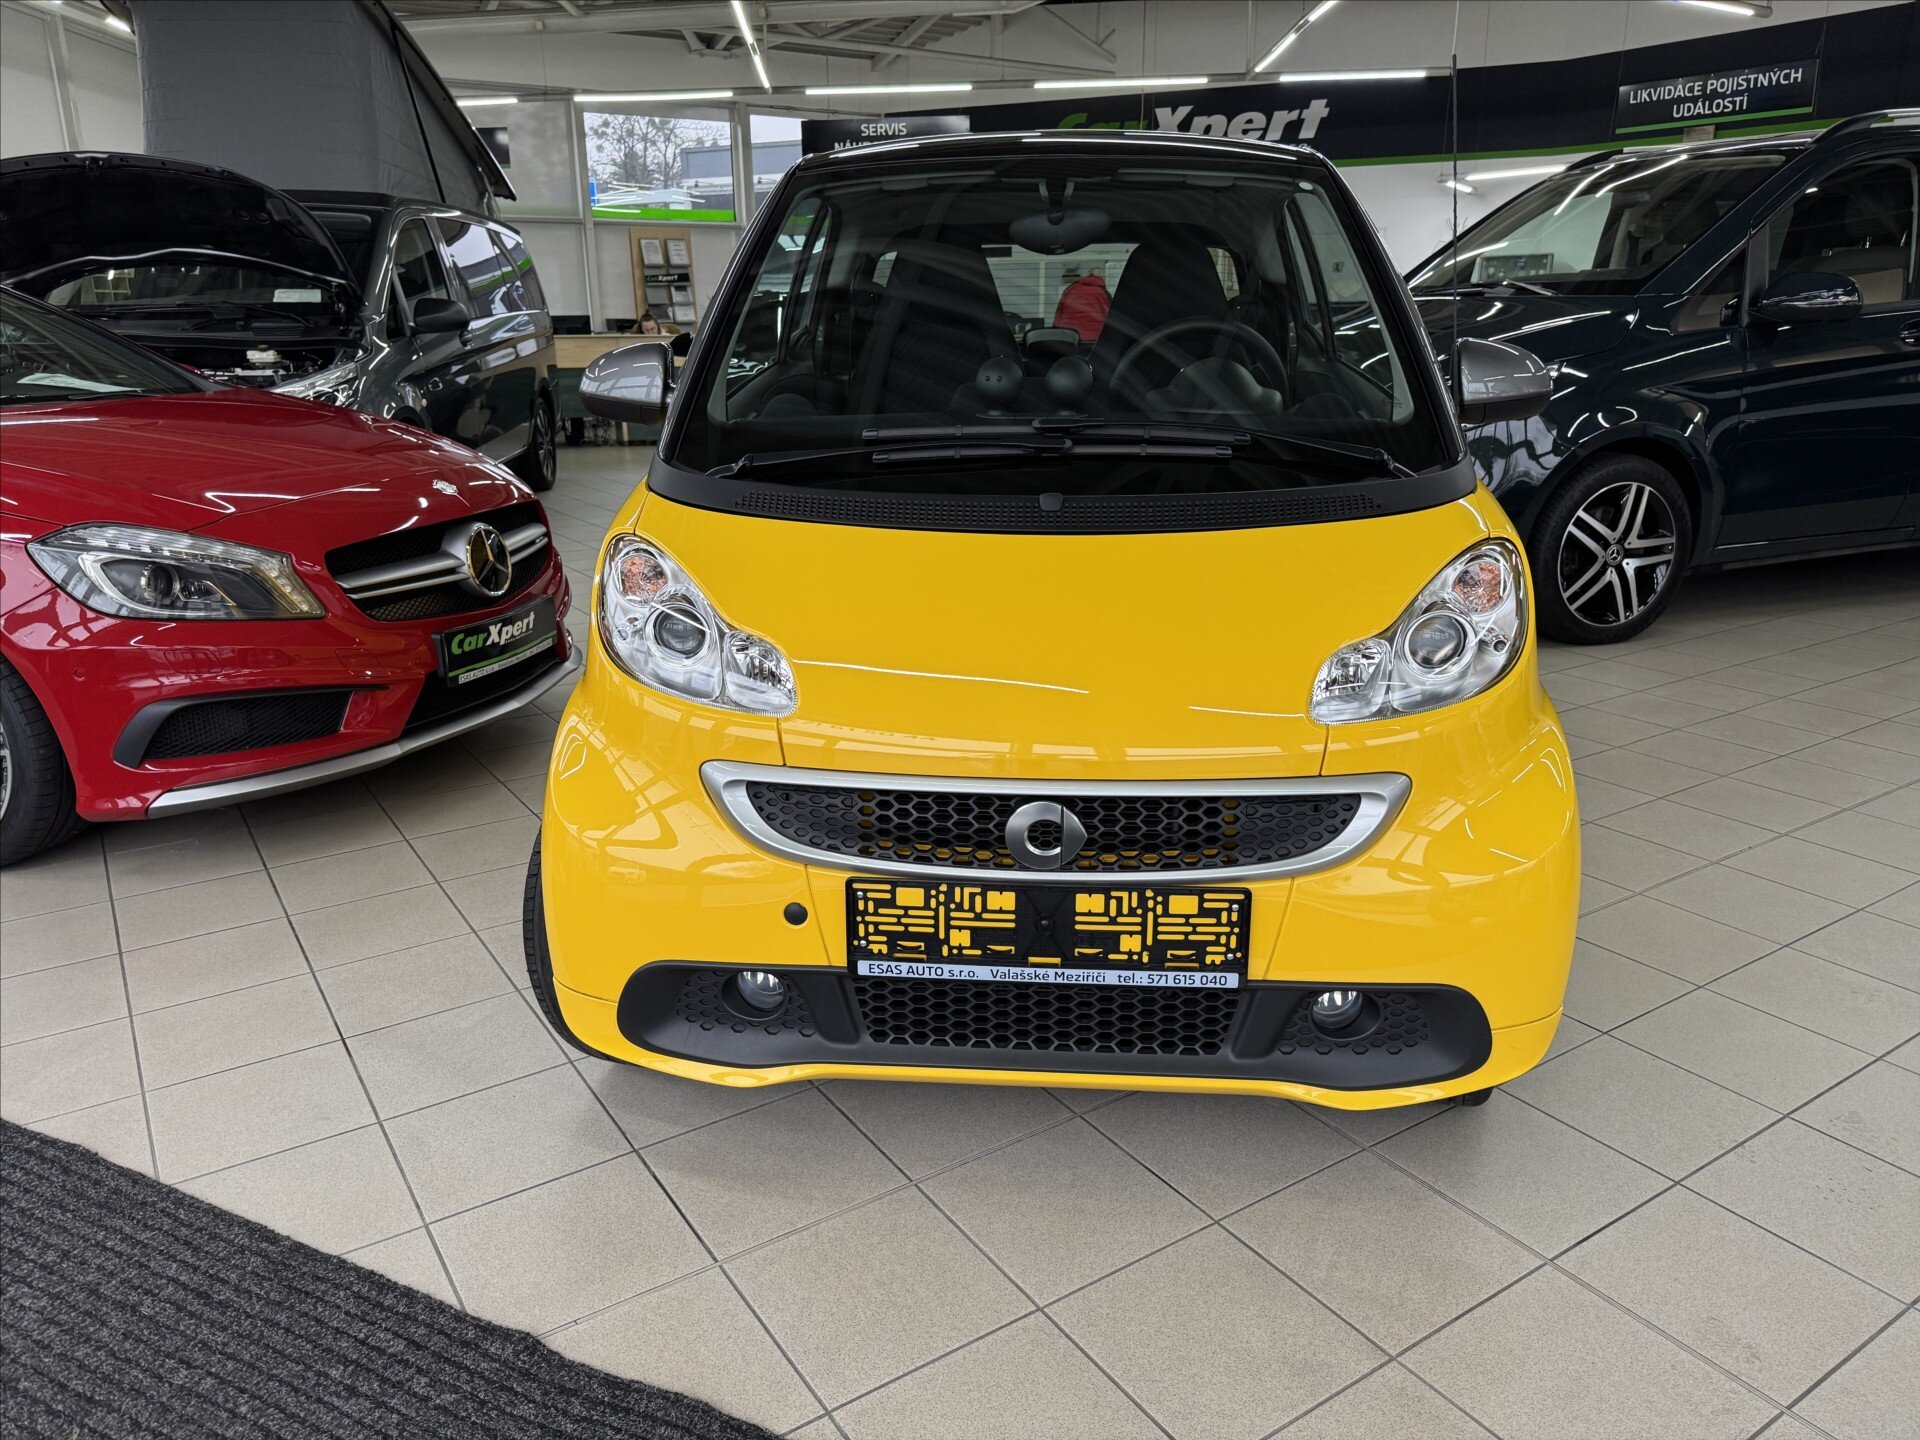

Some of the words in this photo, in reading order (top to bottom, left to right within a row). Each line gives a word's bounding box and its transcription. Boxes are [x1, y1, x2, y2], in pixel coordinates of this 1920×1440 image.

[1629, 82, 1702, 104] LIKVIDACE
[1706, 67, 1803, 95] POJISTNÝCH
[1672, 93, 1748, 118] UDÁLOSTÍ
[860, 123, 907, 136] SERVIS
[451, 611, 535, 655] CarXpert
[868, 963, 903, 976] ESAS
[906, 965, 944, 977] AUTO
[948, 969, 979, 979] s.r.o.
[990, 968, 1050, 981] Valašské
[1054, 971, 1106, 983] Meziříčí
[1117, 974, 1143, 984] tel.:
[1147, 974, 1168, 985] 571
[1173, 974, 1196, 986] 615
[1200, 975, 1227, 987] 040
